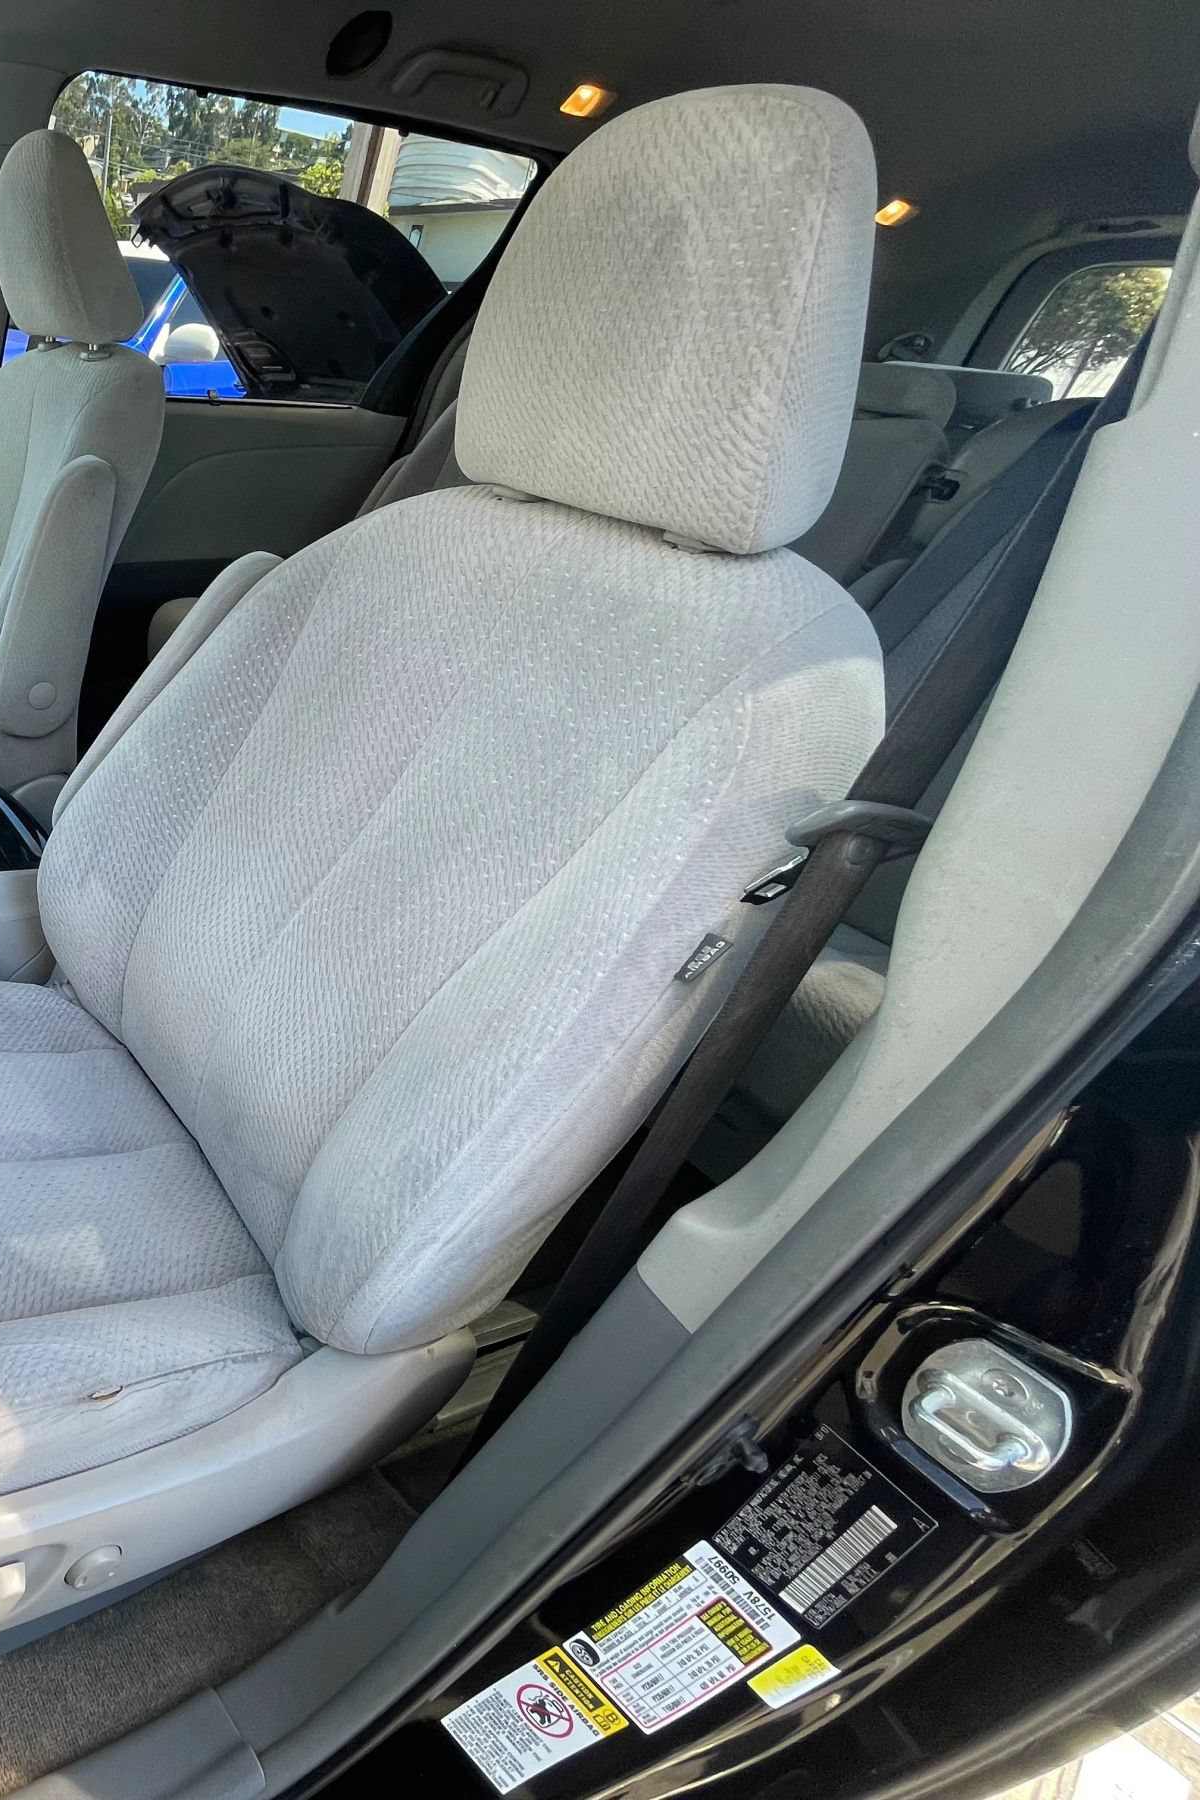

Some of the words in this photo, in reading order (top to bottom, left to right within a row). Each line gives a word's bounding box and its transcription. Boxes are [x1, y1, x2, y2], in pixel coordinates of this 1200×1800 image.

[911, 1515, 928, 1531] A
[706, 1553, 741, 1585] 50997
[590, 1618, 606, 1632] TIRE
[602, 1609, 618, 1622] AND
[614, 1591, 643, 1614] LOADING
[638, 1562, 683, 1596] INFORMATION
[741, 1588, 777, 1621] 1578V
[531, 1663, 550, 1681] SRS
[547, 1680, 569, 1702] SIDE
[567, 1702, 601, 1736] AIRBAG
[558, 1672, 595, 1710] ATTENTION
[563, 1668, 595, 1699] CAUTION
[605, 1712, 619, 1723] B
